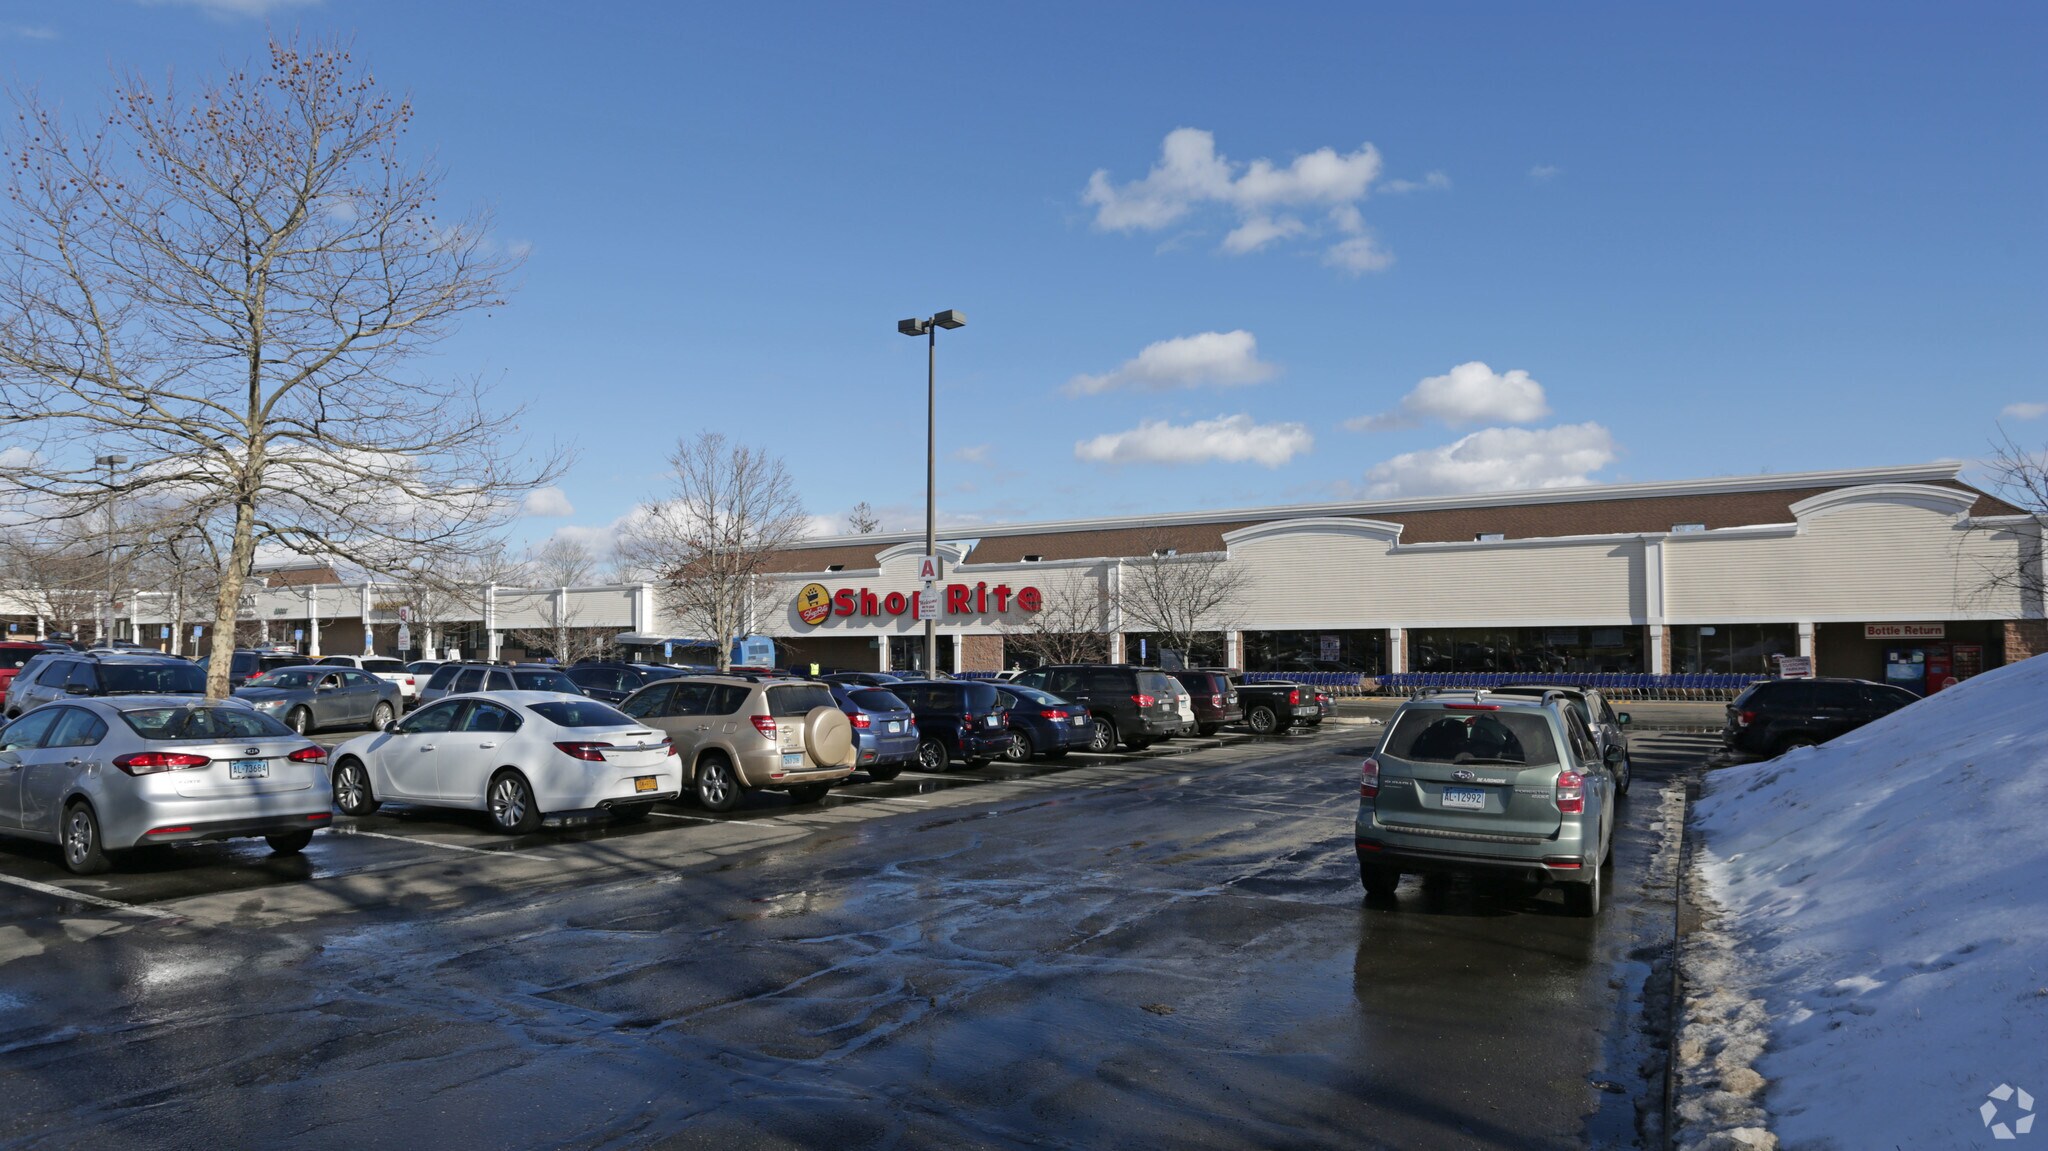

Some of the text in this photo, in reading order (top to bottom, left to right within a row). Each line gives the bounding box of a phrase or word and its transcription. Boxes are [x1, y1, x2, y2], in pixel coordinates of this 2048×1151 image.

[920, 560, 934, 577] A
[1867, 625, 1942, 635] Bottle Return
